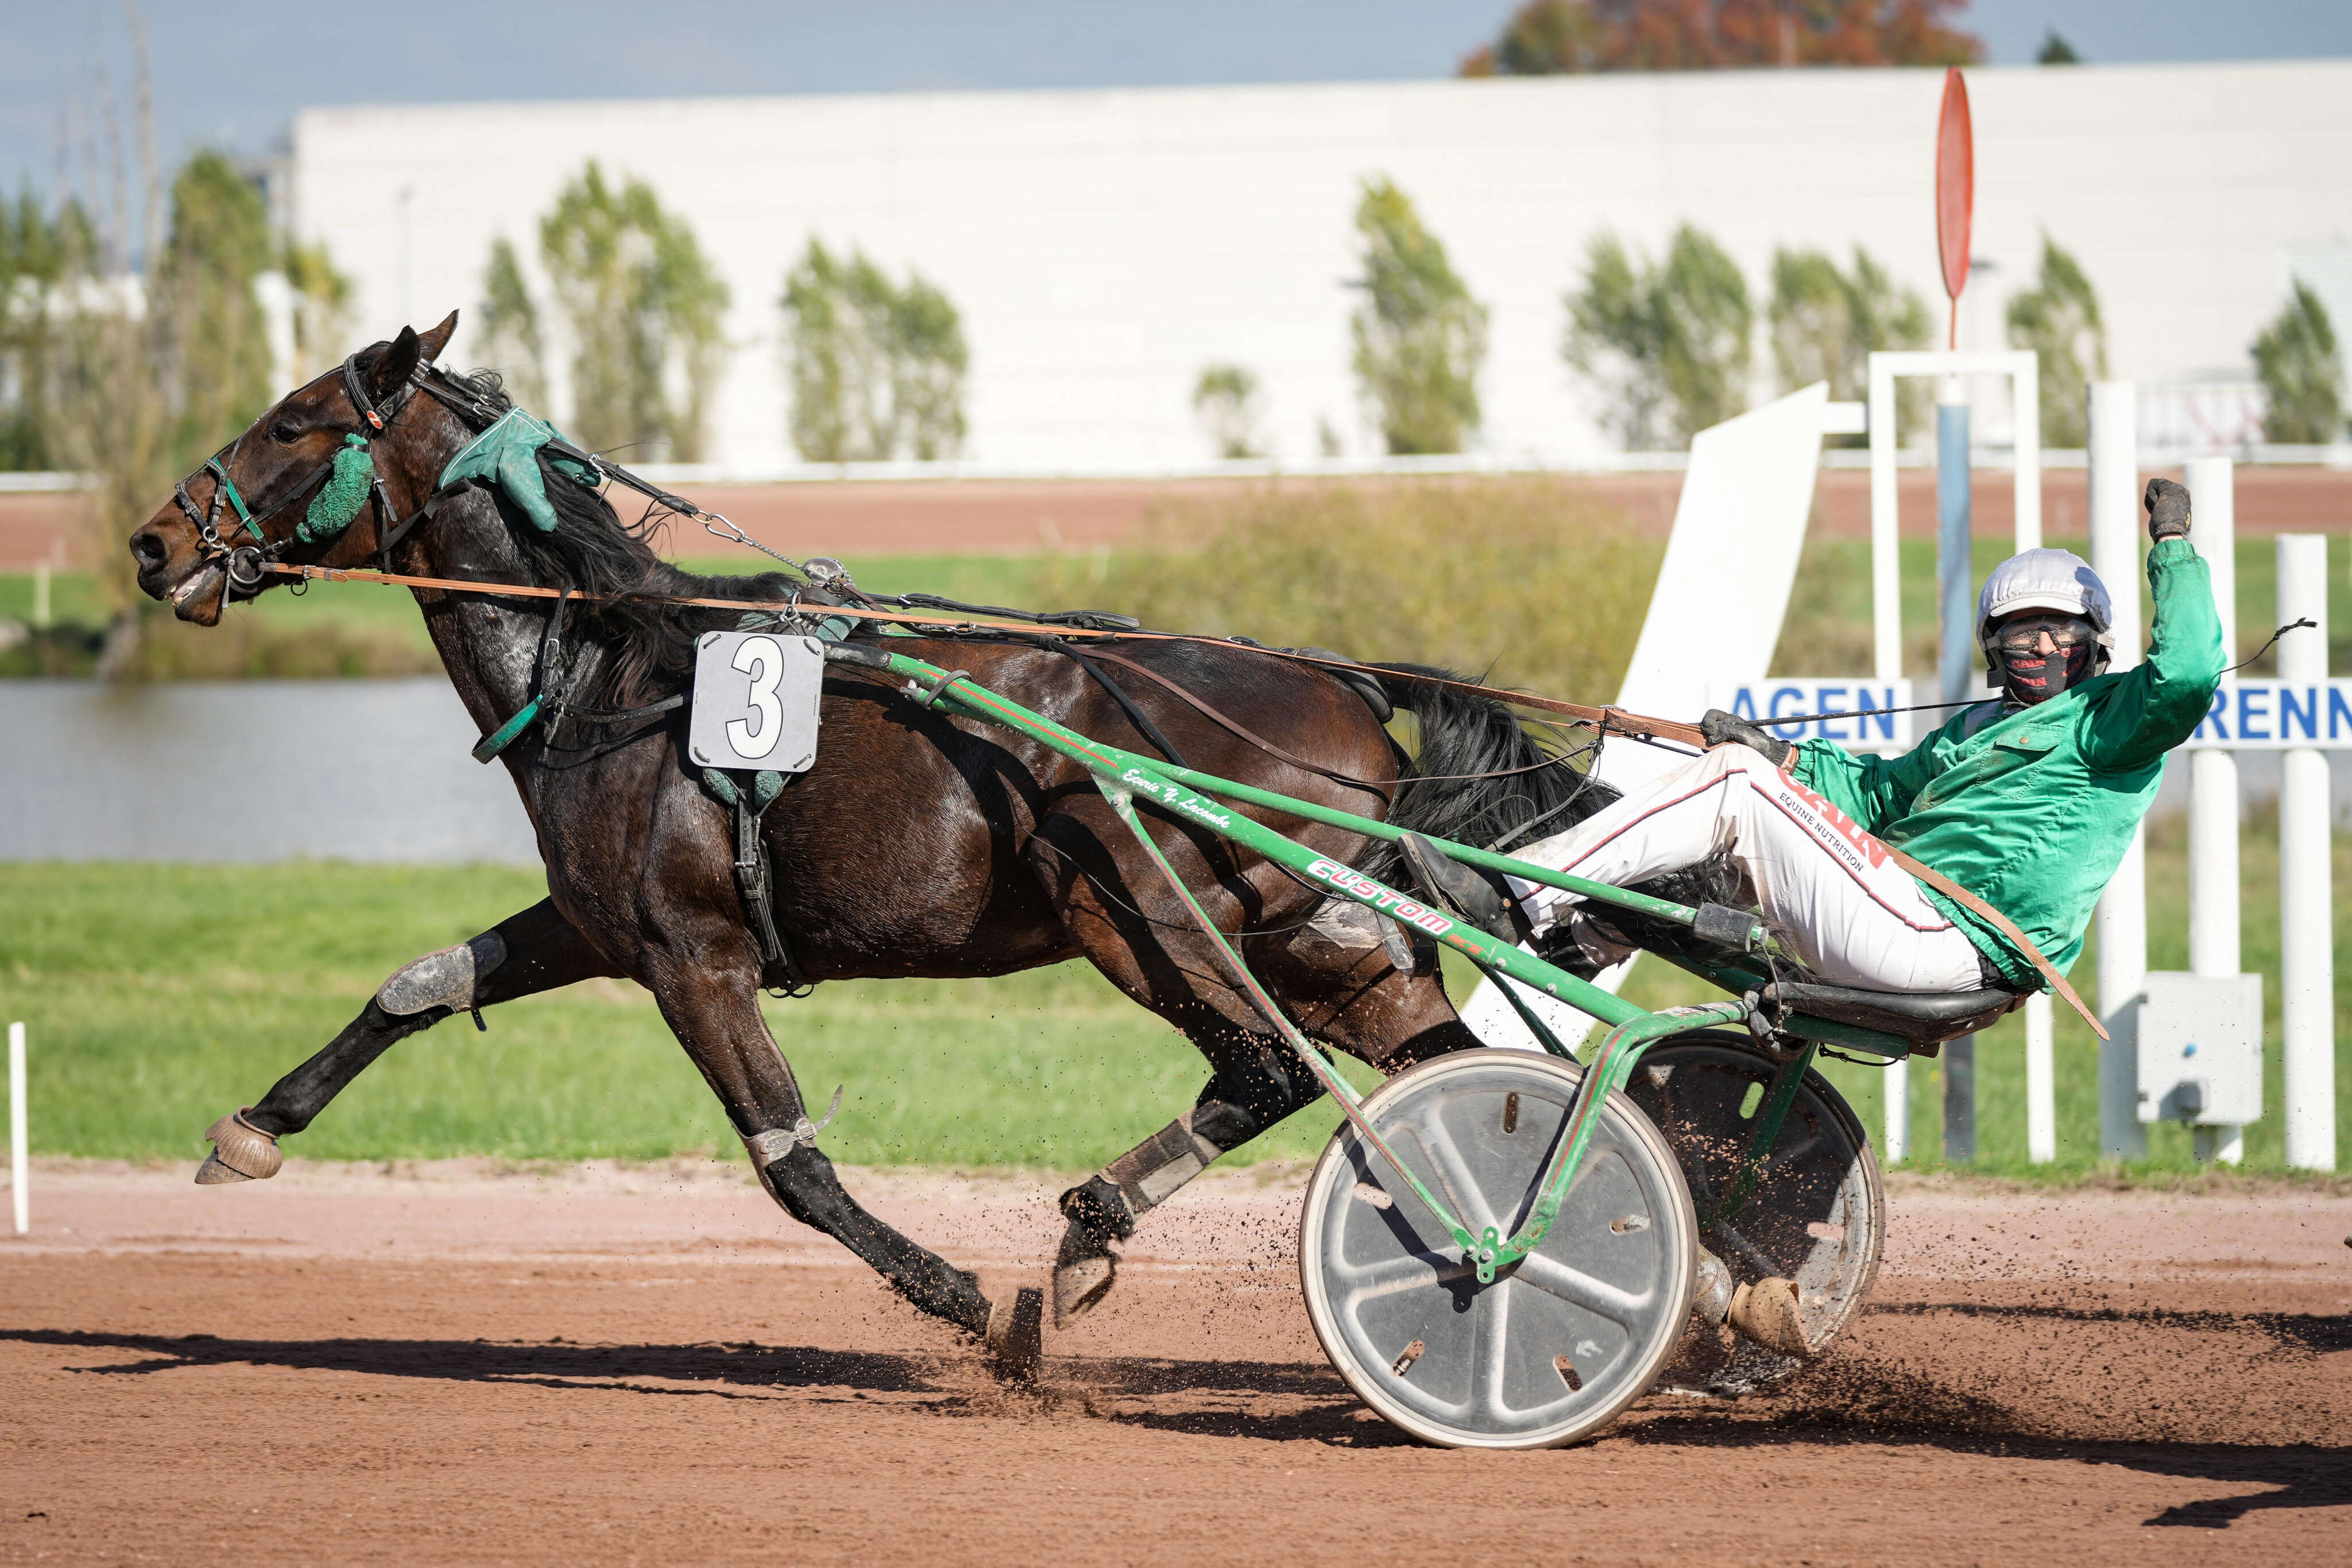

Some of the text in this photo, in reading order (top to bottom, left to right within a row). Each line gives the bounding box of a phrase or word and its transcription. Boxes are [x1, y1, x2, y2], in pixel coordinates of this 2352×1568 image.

[726, 636, 784, 760] 3
[1178, 798, 1231, 828] Lacombe
[1780, 792, 1864, 872] EQUINE NUTRITION
[1307, 859, 1453, 935] CUSTOM
